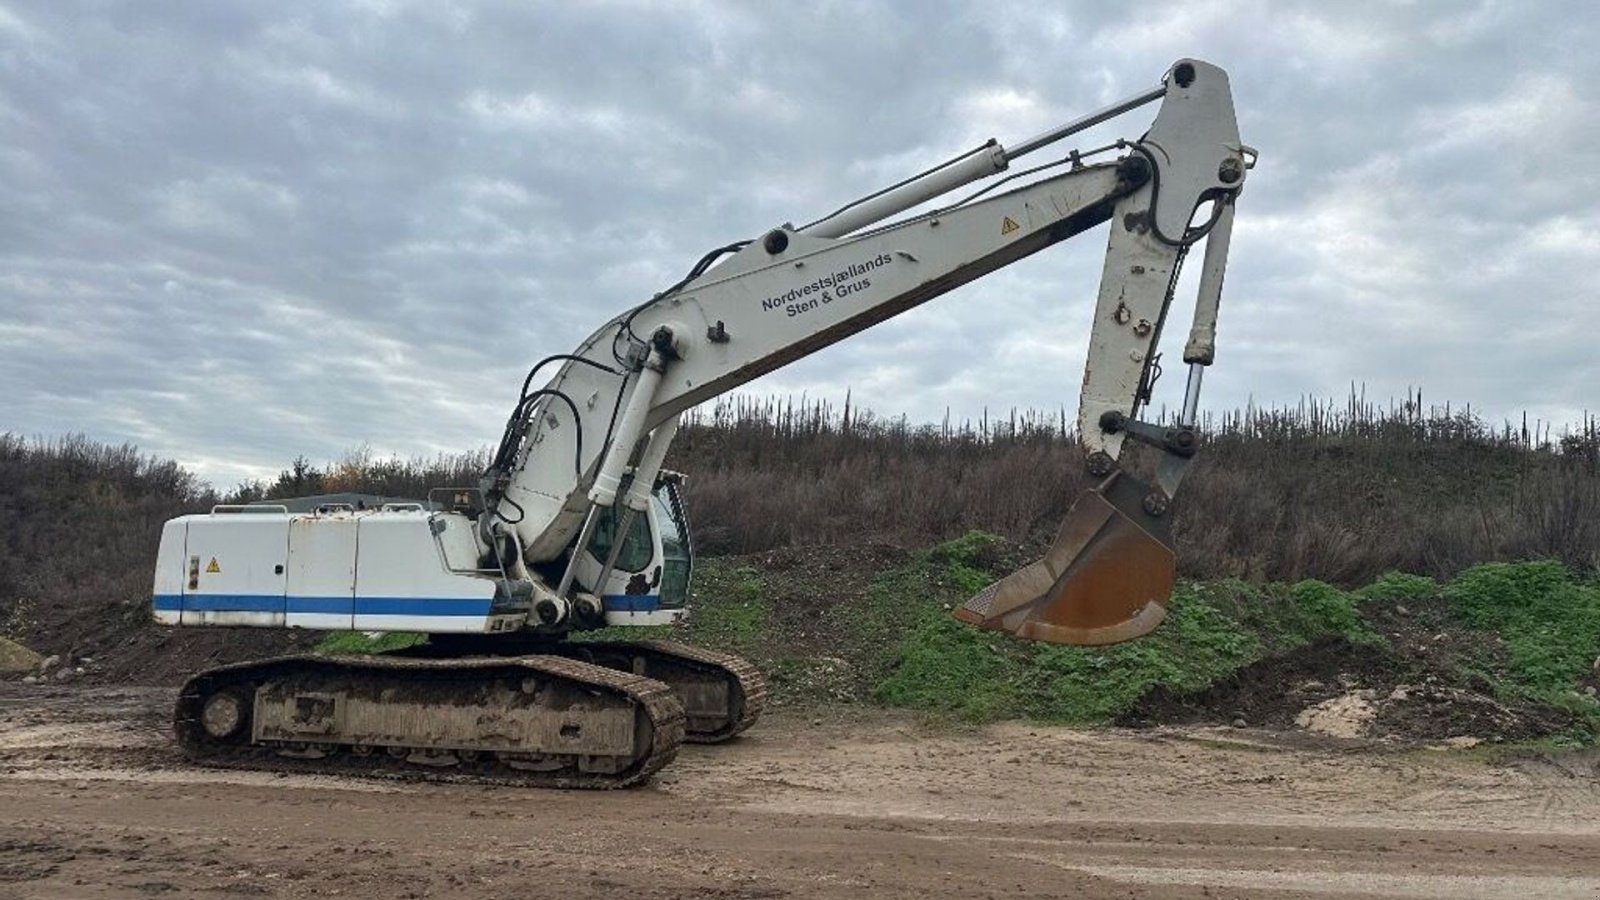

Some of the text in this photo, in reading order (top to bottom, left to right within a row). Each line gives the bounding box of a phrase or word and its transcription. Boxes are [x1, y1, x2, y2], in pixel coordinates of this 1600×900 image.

[762, 253, 892, 312] Nordvestsjællands
[786, 278, 871, 317] Sten & Grus
